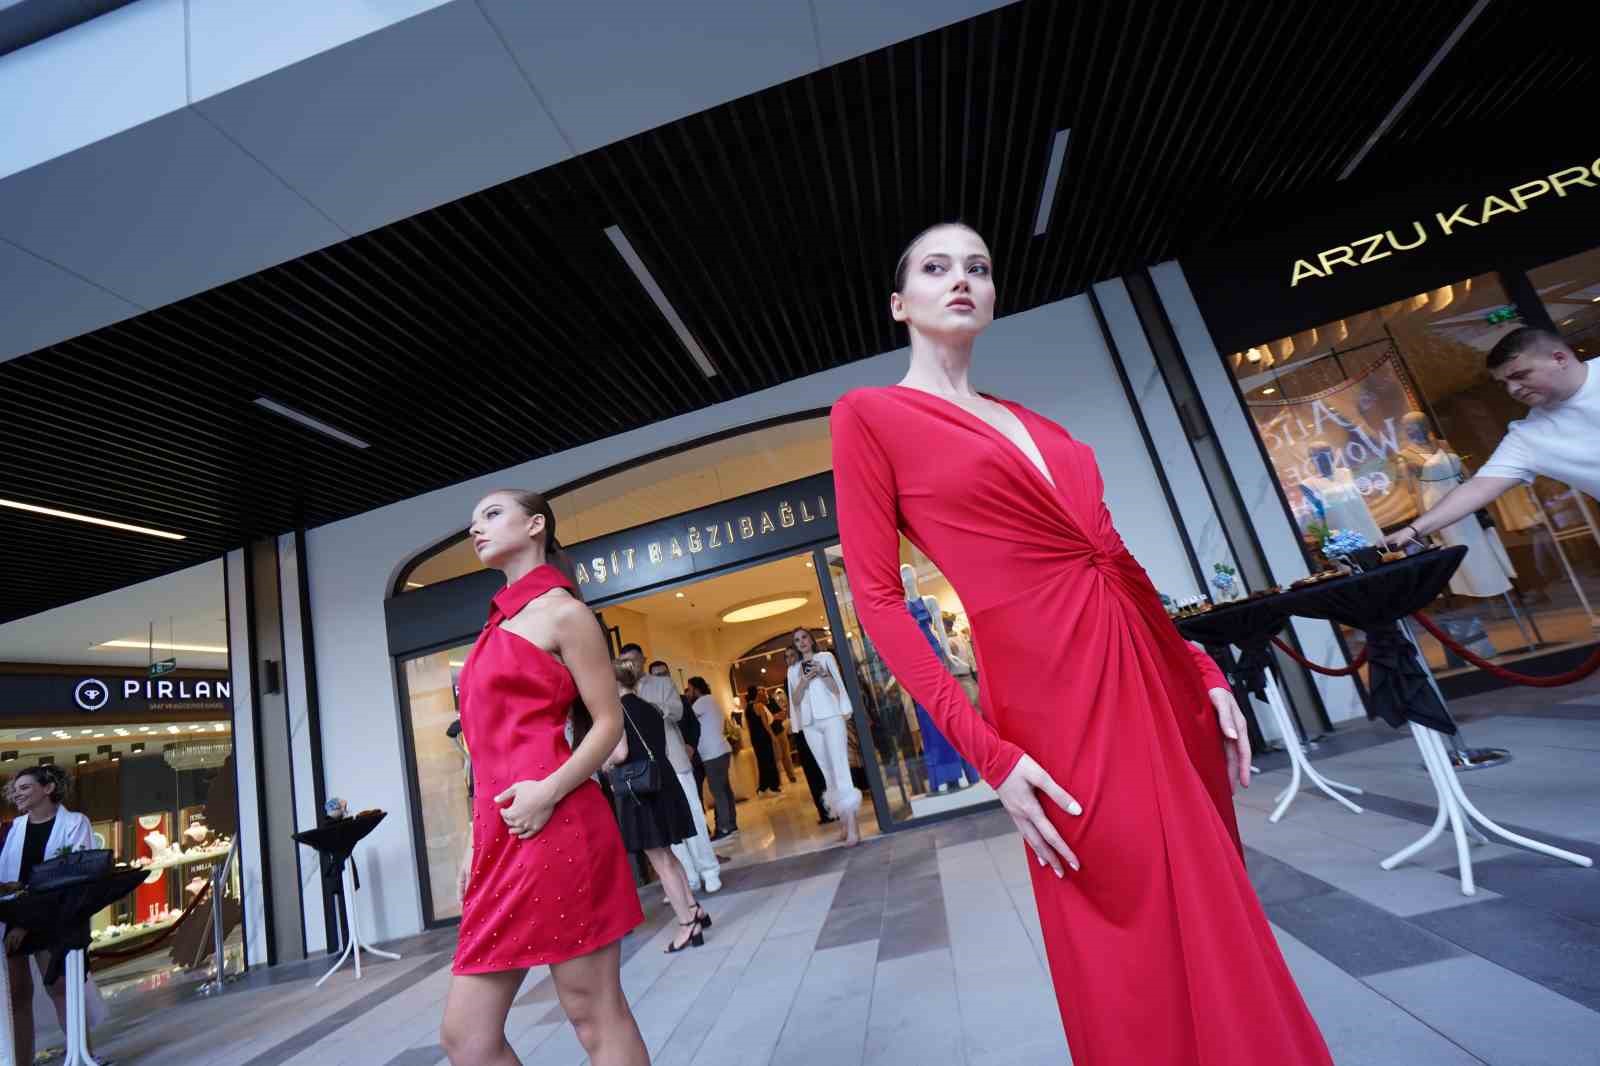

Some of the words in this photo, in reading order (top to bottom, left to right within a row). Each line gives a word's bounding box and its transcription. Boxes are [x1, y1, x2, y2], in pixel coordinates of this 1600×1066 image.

[1290, 221, 1427, 287] ARZU
[1435, 158, 1600, 236] KAPR
[124, 680, 230, 699] PIRLAN
